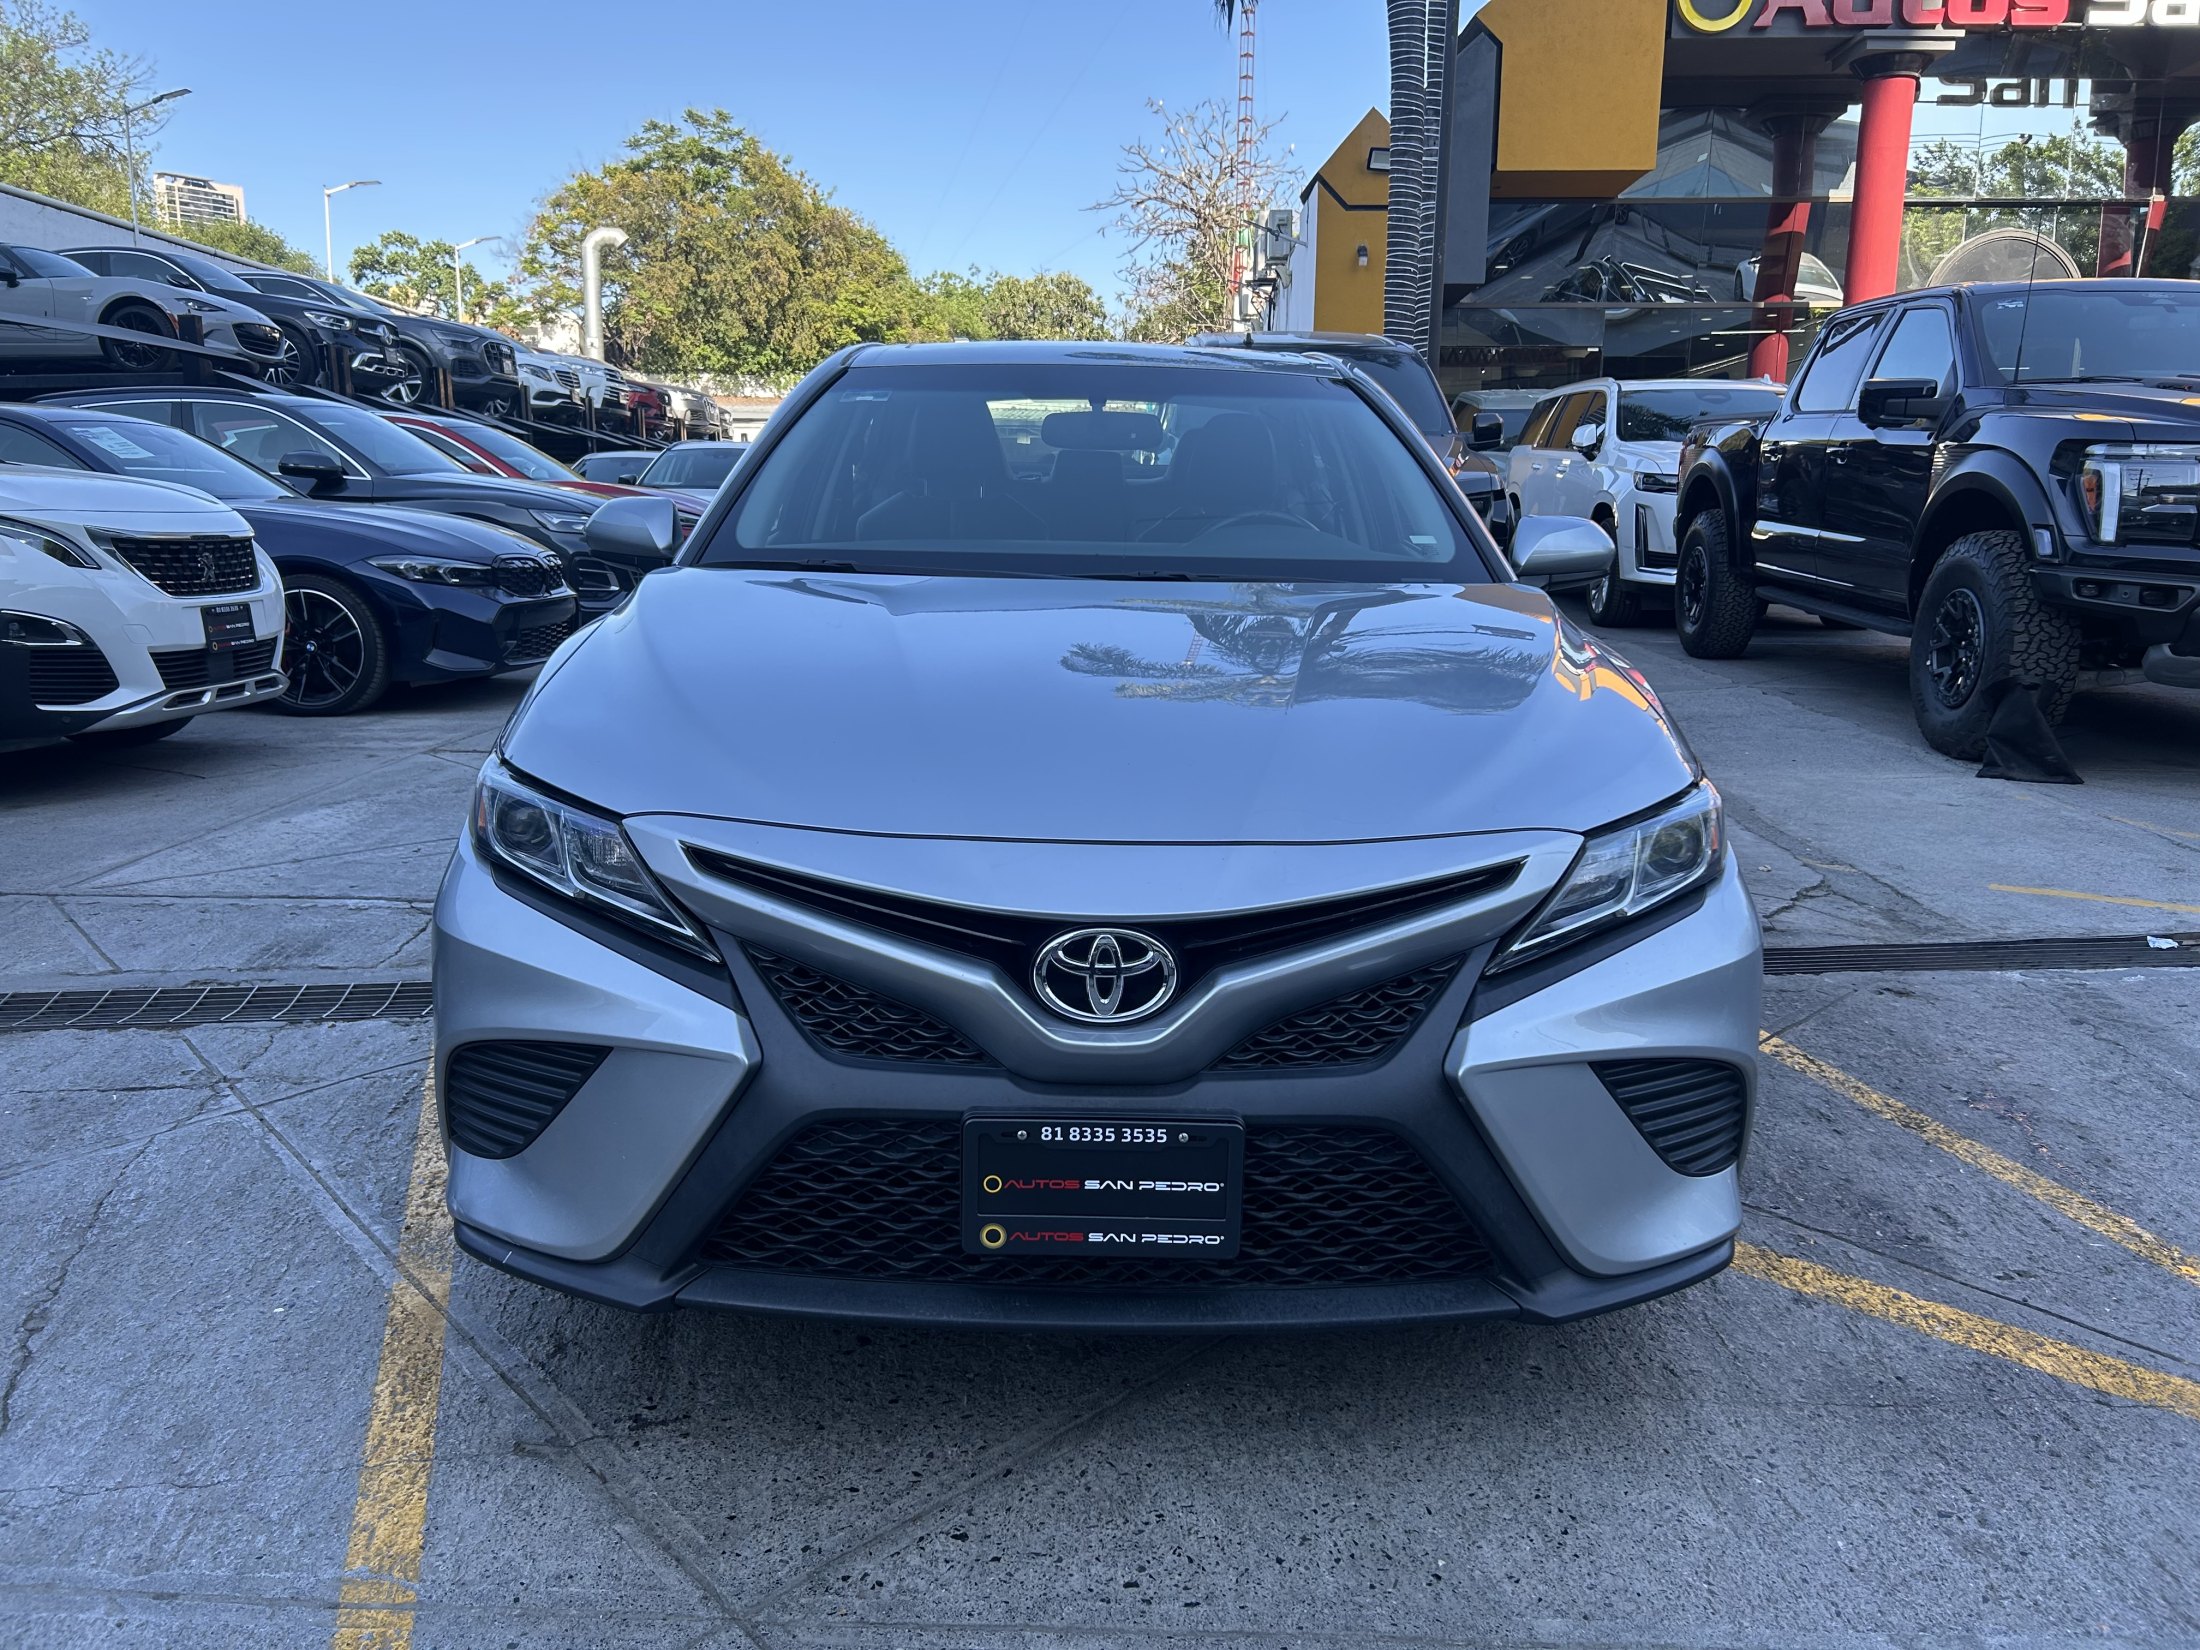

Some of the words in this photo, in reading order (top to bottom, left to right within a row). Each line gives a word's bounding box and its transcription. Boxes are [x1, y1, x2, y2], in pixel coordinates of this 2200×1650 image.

[1041, 1126, 1064, 1141] 81
[1069, 1126, 1116, 1142] 8335
[1121, 1128, 1168, 1143] 3535
[1004, 1179, 1080, 1190] AUTOS
[1084, 1180, 1134, 1190] SAN
[1138, 1180, 1220, 1192] PEDRO
[1009, 1231, 1084, 1242] AUTOS
[1088, 1232, 1137, 1244] SAN
[1141, 1233, 1222, 1245] PEDRO
